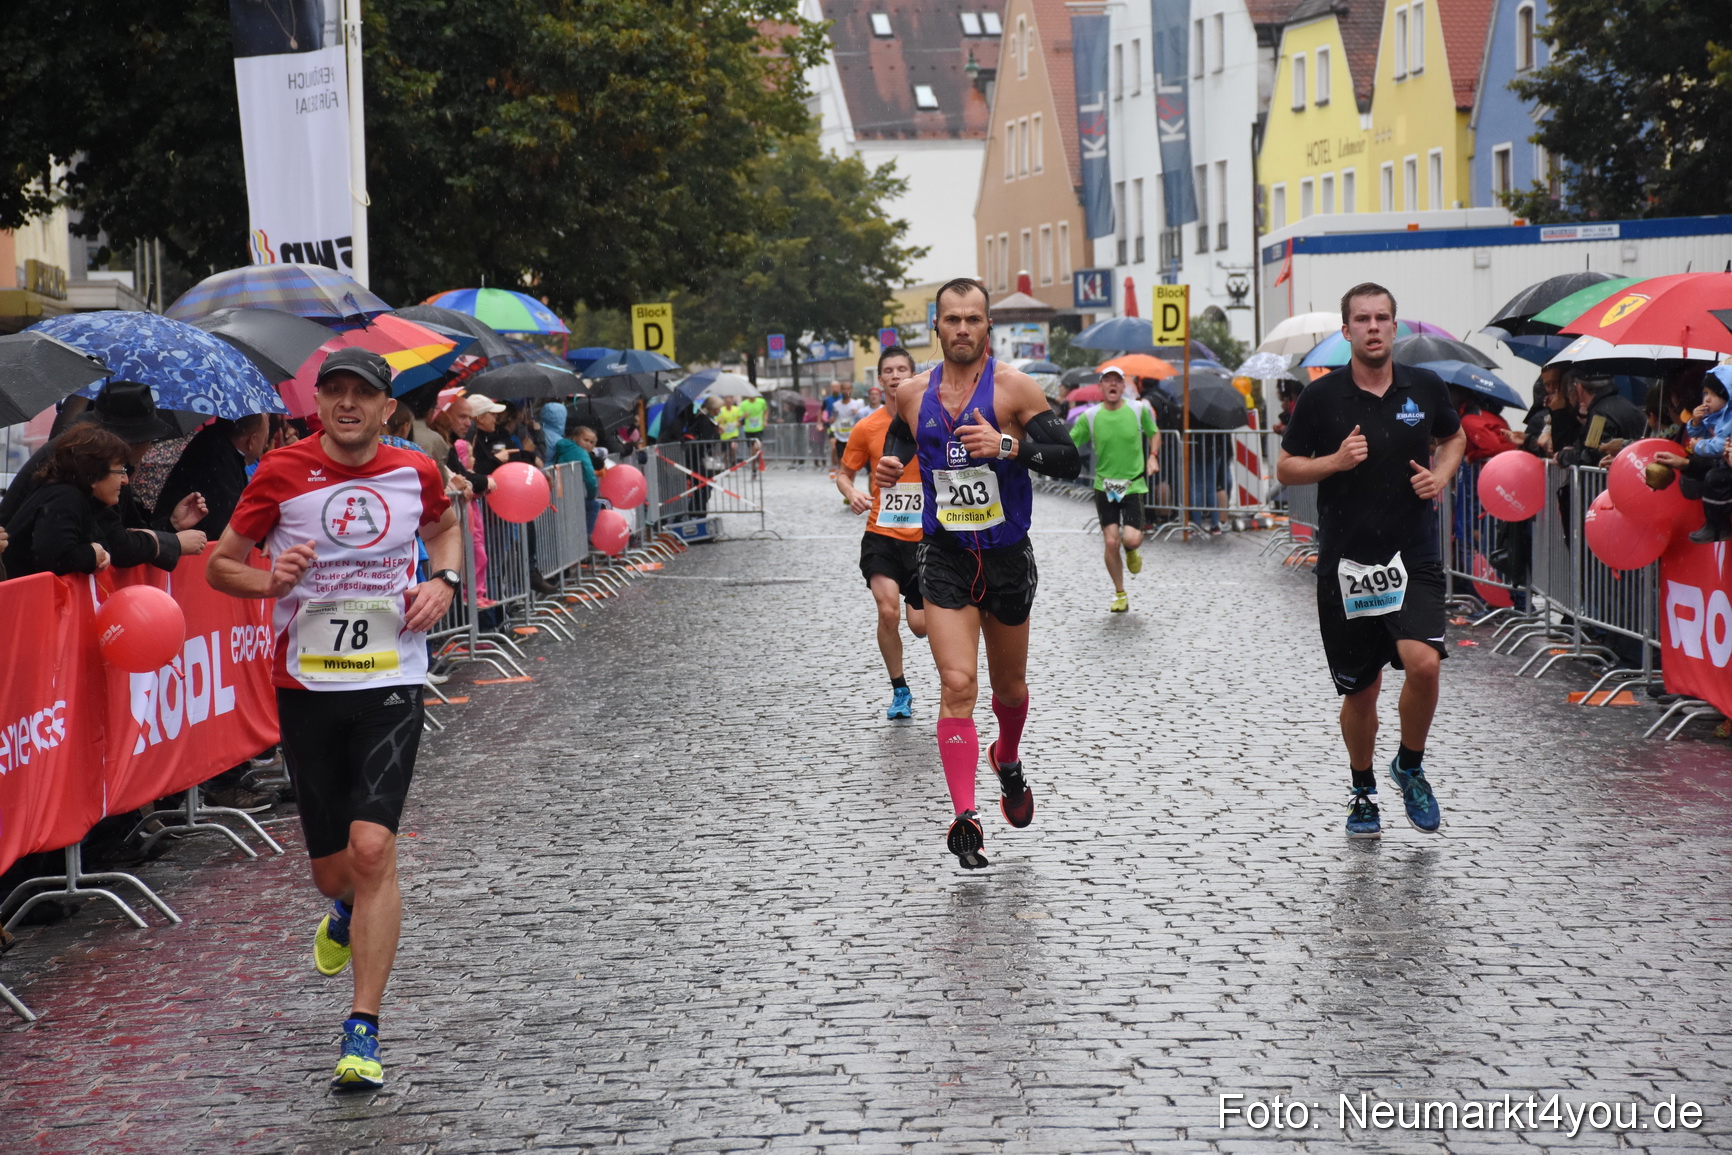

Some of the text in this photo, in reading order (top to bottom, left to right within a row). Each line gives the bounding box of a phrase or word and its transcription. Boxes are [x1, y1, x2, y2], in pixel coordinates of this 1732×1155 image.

[1306, 138, 1331, 167] HOTEL
[1157, 286, 1186, 299] Block
[636, 306, 667, 318] Block
[1162, 303, 1181, 332] D
[643, 322, 663, 351] D
[949, 443, 968, 458] a3
[949, 457, 968, 465] sports
[948, 480, 990, 507] 203
[885, 493, 922, 511] 2573
[892, 514, 910, 523] Peter
[945, 508, 995, 522] Christian K.
[355, 559, 378, 568] MIT
[315, 573, 328, 581] Dr.
[357, 570, 370, 579] Dr.
[1346, 566, 1403, 595] 2499
[343, 599, 392, 611] BOCK
[329, 618, 369, 652] 78
[324, 656, 375, 670] Michael
